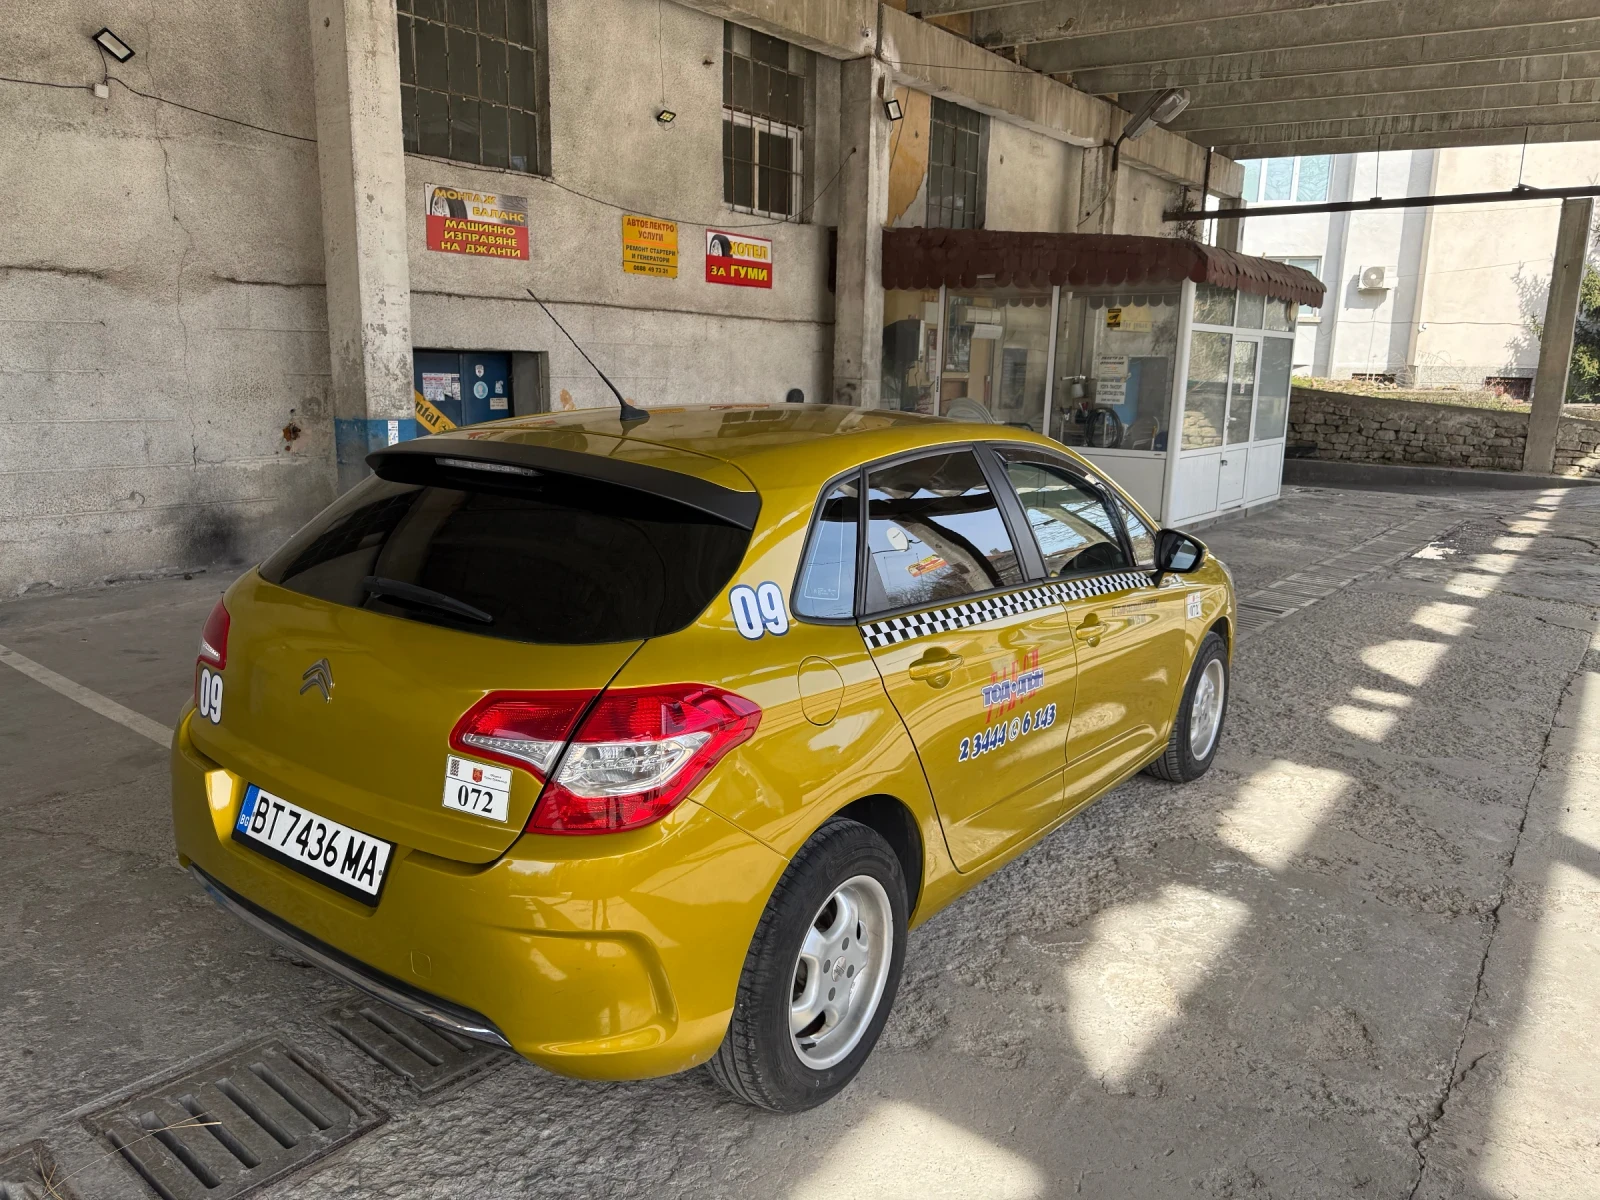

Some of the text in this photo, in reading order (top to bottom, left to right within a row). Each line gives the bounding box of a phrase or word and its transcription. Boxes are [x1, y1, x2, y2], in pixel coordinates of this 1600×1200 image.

[434, 188, 496, 205] МОНТАЖ
[472, 206, 525, 223] БАЛАНС
[445, 219, 516, 236] МАШИННО
[627, 218, 675, 232] АВТОЕЛЕКТРО
[444, 230, 518, 247] ИЗПРАВЯНЕ
[638, 230, 663, 241] УСЛУГИ
[441, 241, 521, 258] НА ДЖАНТИ
[650, 248, 675, 256] СТАРТЕРИ
[729, 240, 769, 260] ХОТЕЛ
[637, 254, 669, 263] ГЕНЕРАТОРИ
[710, 264, 768, 281] ЗА ГУМИ
[728, 580, 790, 641] 09
[199, 666, 224, 725] 09
[959, 702, 1057, 762] 2 3444 6 143
[458, 785, 493, 813] 072
[240, 813, 250, 827] BG
